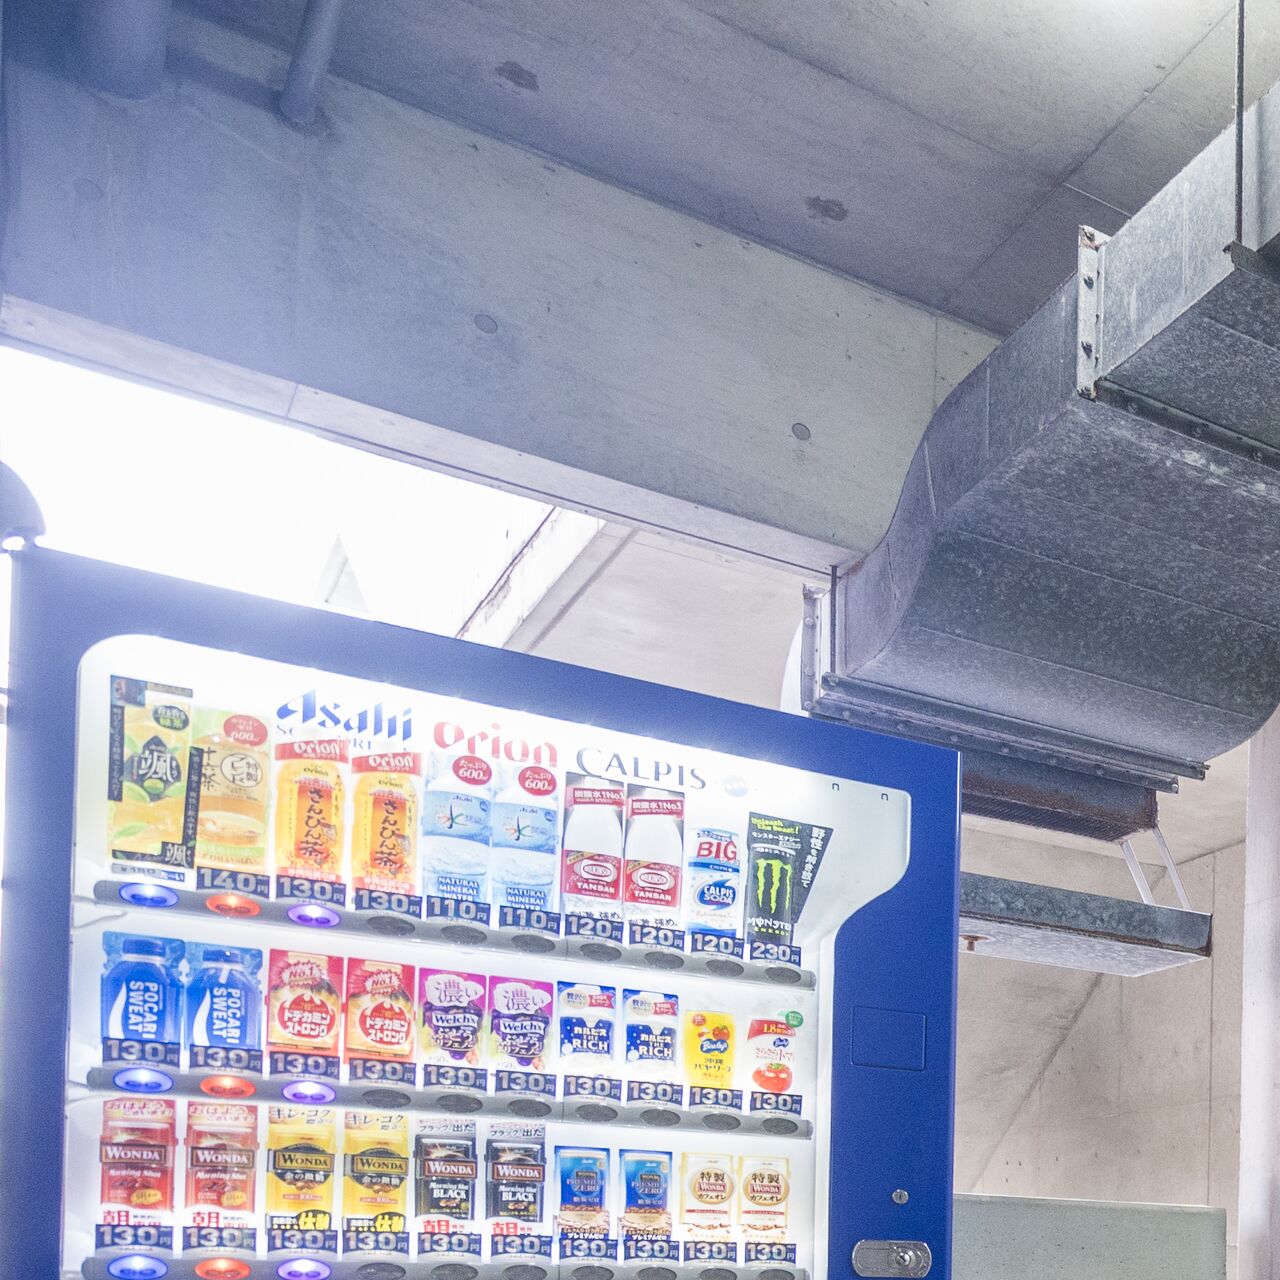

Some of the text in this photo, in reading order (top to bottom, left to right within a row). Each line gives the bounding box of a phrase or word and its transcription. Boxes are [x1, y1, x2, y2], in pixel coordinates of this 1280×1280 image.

[276, 688, 412, 742] Asahi
[576, 746, 706, 790] CALPIS
[300, 787, 326, 861] さんびん茶
[374, 799, 402, 874] さんびん茶
[696, 840, 738, 861] BIG
[200, 868, 269, 894] 140円
[278, 876, 345, 902] 130円
[437, 876, 480, 889] NATURAL
[438, 884, 478, 897] MINERAL
[576, 881, 615, 894] TANSAN
[505, 887, 546, 900] NATURAL
[506, 895, 545, 906] MINERAL
[633, 889, 672, 902] TANSAN
[703, 884, 734, 898] CALPIS
[357, 891, 421, 914] 130円
[430, 897, 488, 922] 110円
[503, 907, 557, 930] 110円
[568, 915, 621, 939] 120円
[632, 924, 683, 947] 120円
[694, 934, 742, 955] 120円
[752, 941, 799, 963] 230円
[435, 979, 479, 1004] 濃い
[503, 987, 545, 1012] 濃い
[128, 980, 144, 1033] SWEAT
[142, 981, 159, 1039] POCARI
[212, 986, 228, 1039] SWEAT
[226, 988, 241, 1044] POCARI
[283, 1009, 331, 1026] ドデカミン
[366, 1016, 409, 1031] ドデカミン
[434, 1014, 476, 1026] Welch's
[502, 1021, 542, 1033] Welch's
[285, 1021, 329, 1037] ストロング
[367, 1028, 408, 1043] ストロング
[106, 1039, 178, 1064] 130円
[572, 1038, 609, 1052] RICH
[638, 1044, 673, 1058] RICH
[192, 1046, 261, 1070] 130円
[273, 1053, 338, 1077] 130円
[352, 1060, 415, 1082] 130円
[427, 1065, 486, 1087] 130円
[498, 1071, 556, 1092] 130円
[566, 1076, 620, 1098] 130円
[629, 1082, 681, 1103] 130円
[691, 1087, 741, 1106] 130円
[752, 1093, 801, 1112] 130円
[105, 1145, 161, 1161] WONDA
[197, 1149, 249, 1164] WONDA
[281, 1153, 329, 1167] WONDA
[359, 1157, 404, 1171] WONDA
[428, 1161, 473, 1175] WONDA
[497, 1164, 540, 1178] WONDA
[699, 1171, 725, 1183] 特製
[751, 1172, 780, 1184] 特製
[432, 1188, 467, 1200] BLACK
[501, 1191, 535, 1202] BLACK
[696, 1192, 727, 1201] カフェオレ
[698, 1182, 726, 1192] WONDA
[751, 1183, 779, 1193] WONDA
[750, 1194, 782, 1202] カフェオレ
[99, 1224, 171, 1246] 130円
[186, 1227, 254, 1249] 130円
[271, 1229, 337, 1250] 130円
[346, 1231, 408, 1251] 130円
[420, 1233, 480, 1252] 130円
[493, 1235, 551, 1253] 130円
[562, 1240, 617, 1258] 130円
[626, 1240, 678, 1258] 130円
[686, 1242, 736, 1259] 130円
[747, 1243, 795, 1260] 130円
